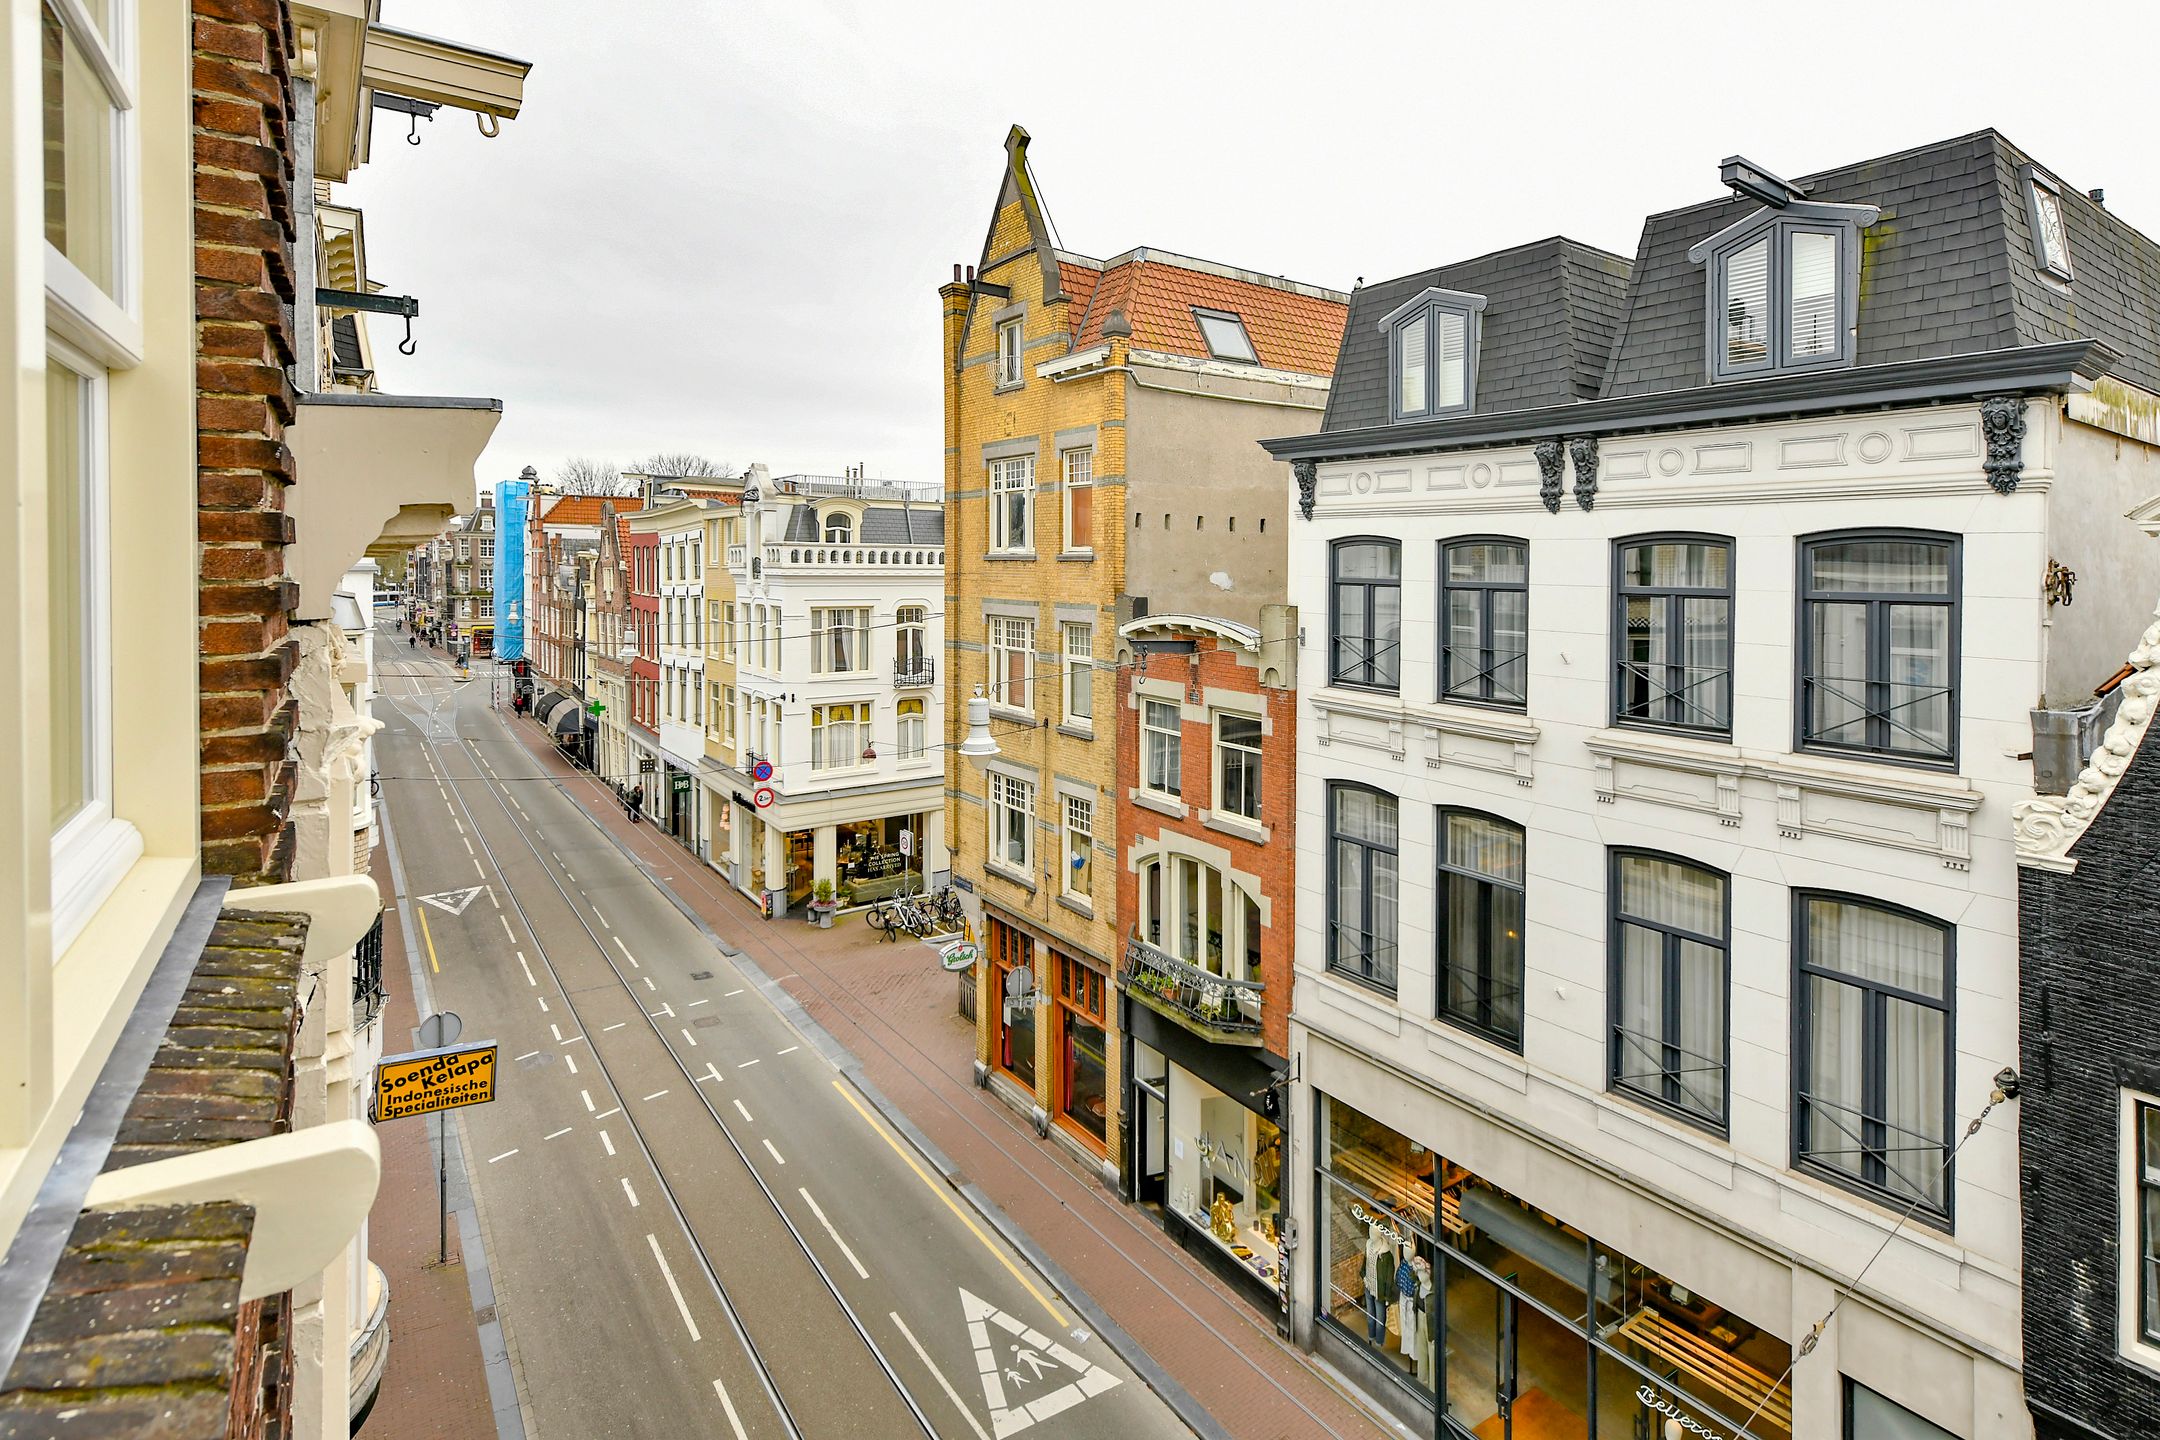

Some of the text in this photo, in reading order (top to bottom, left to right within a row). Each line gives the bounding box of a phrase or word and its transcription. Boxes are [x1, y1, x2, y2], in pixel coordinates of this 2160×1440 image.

[868, 857, 901, 867] COLLECTION
[879, 862, 902, 871] ARRIVED
[881, 852, 900, 860] SPRING
[947, 949, 974, 966] Grolsch
[381, 1055, 459, 1093] Soenda
[421, 1055, 493, 1090] Kelapa
[387, 1079, 488, 1105] Indonesische
[384, 1091, 488, 1118] Specialiteiten
